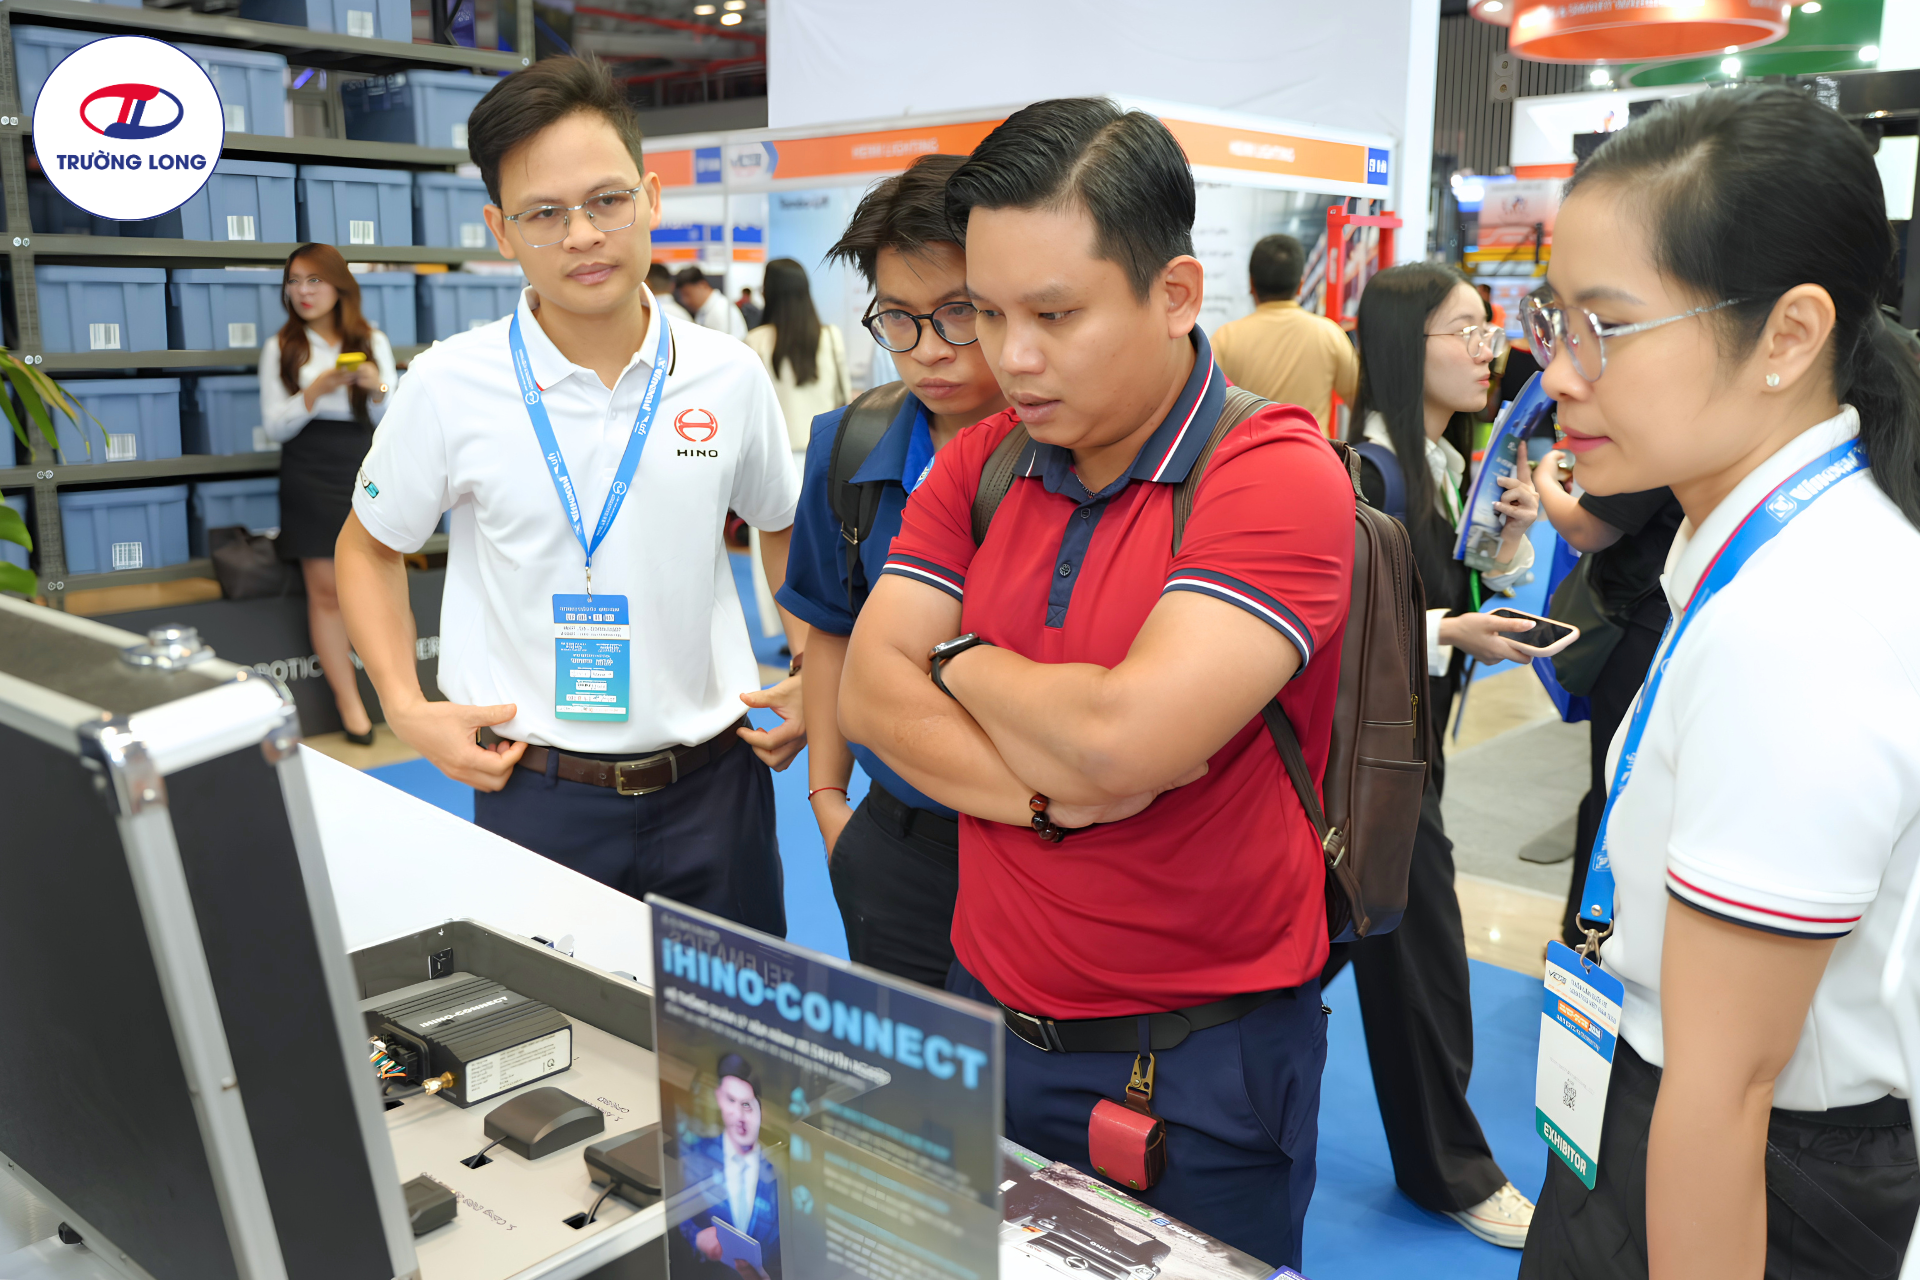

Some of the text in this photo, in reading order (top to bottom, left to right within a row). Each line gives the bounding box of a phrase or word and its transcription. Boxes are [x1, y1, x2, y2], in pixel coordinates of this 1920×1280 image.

[677, 449, 718, 458] HINO
[1544, 1121, 1588, 1176] EXHIBITOR
[1090, 1241, 1112, 1254] HINO
